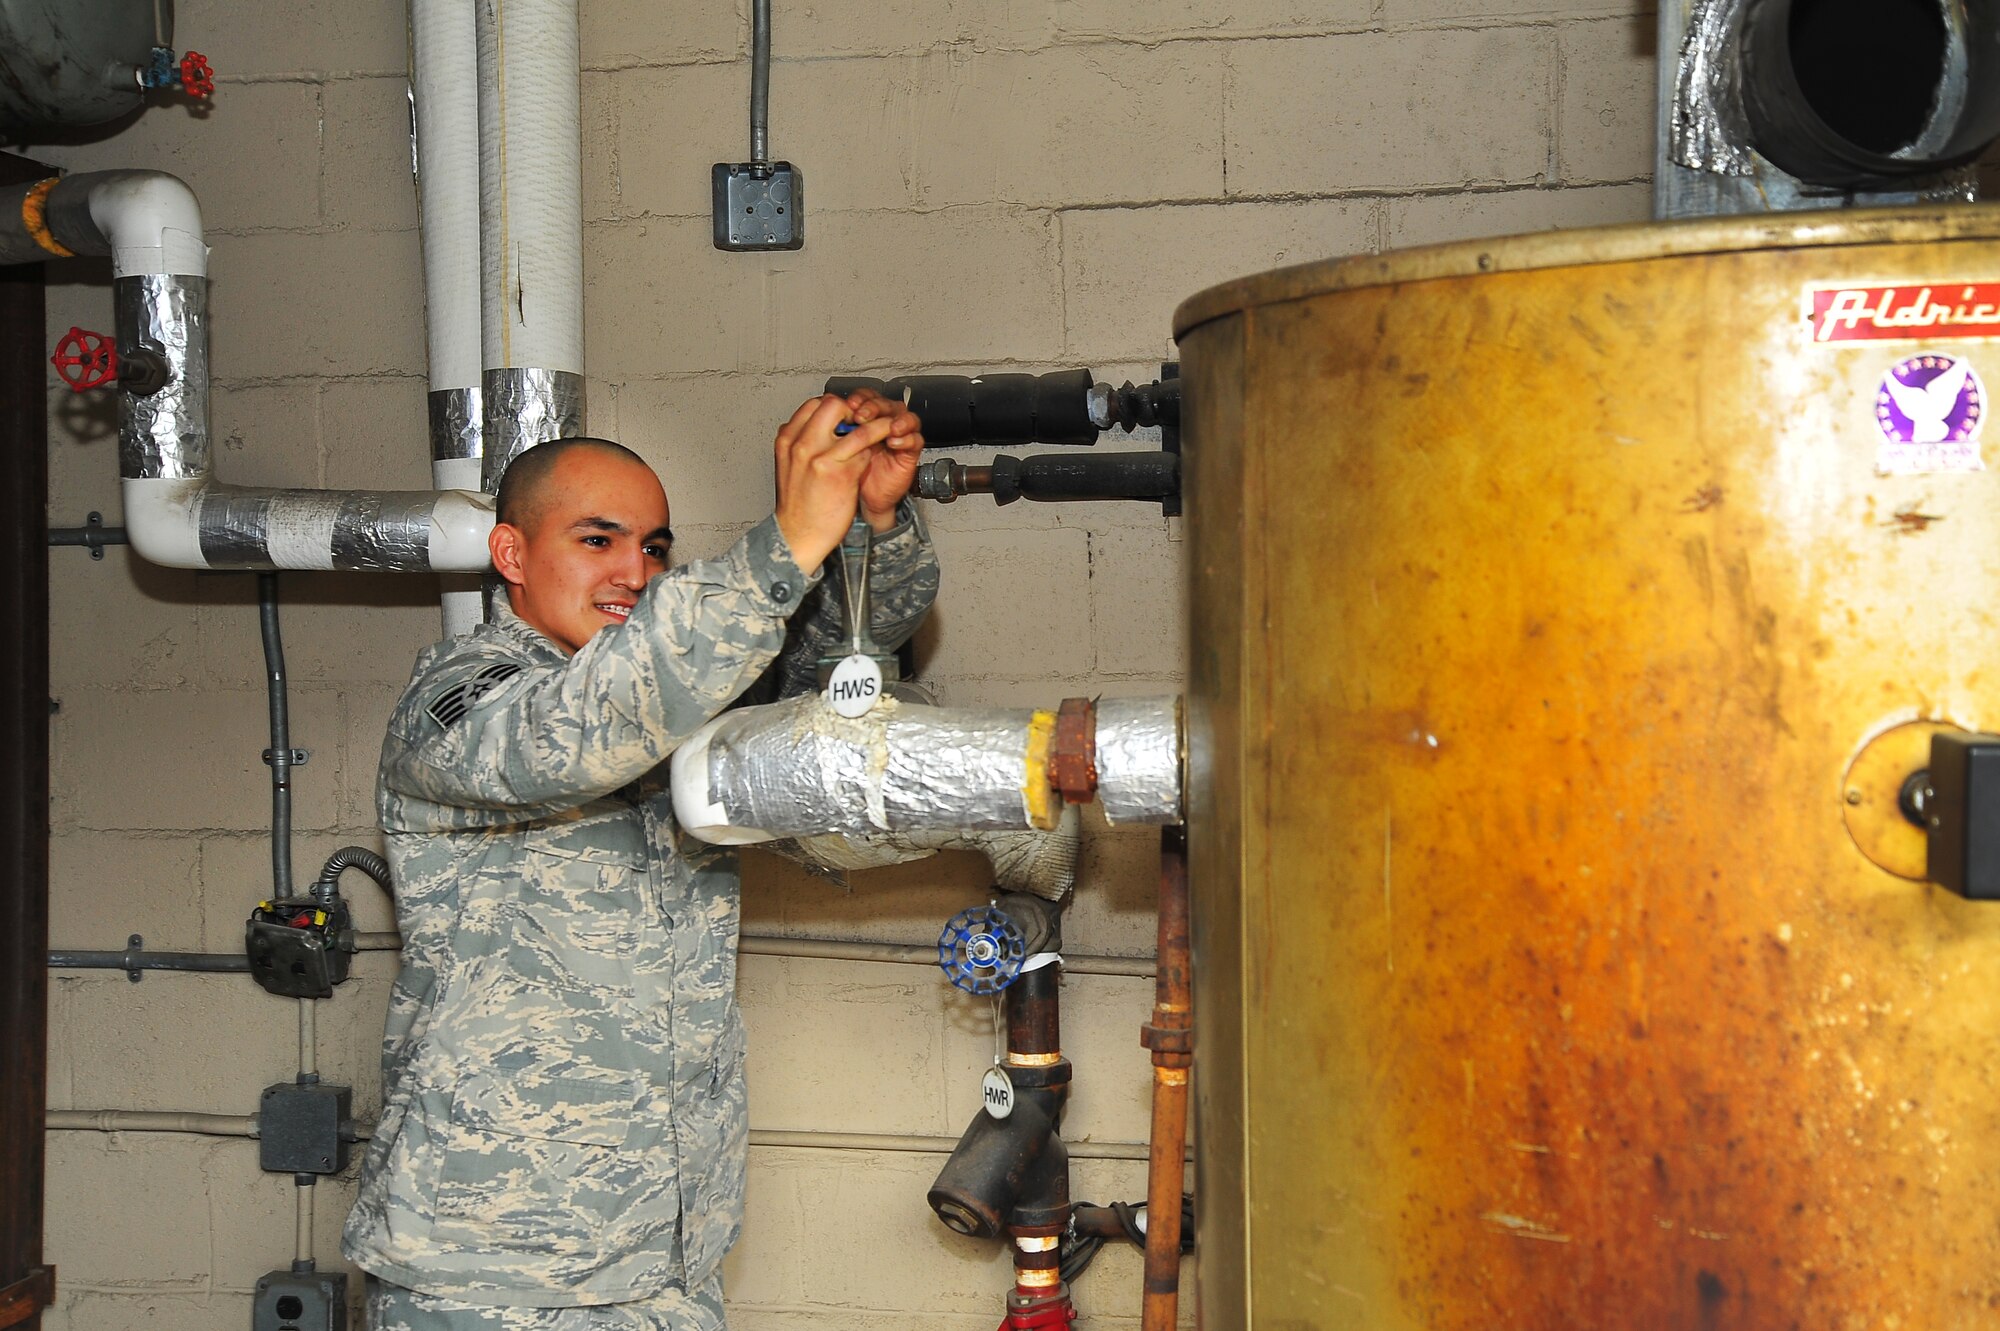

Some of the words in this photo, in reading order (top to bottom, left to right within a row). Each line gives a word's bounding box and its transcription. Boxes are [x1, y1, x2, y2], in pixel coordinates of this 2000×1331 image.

[1817, 287, 2000, 342] Aldric
[833, 677, 875, 702] HWS
[984, 1085, 1009, 1107] HWR
